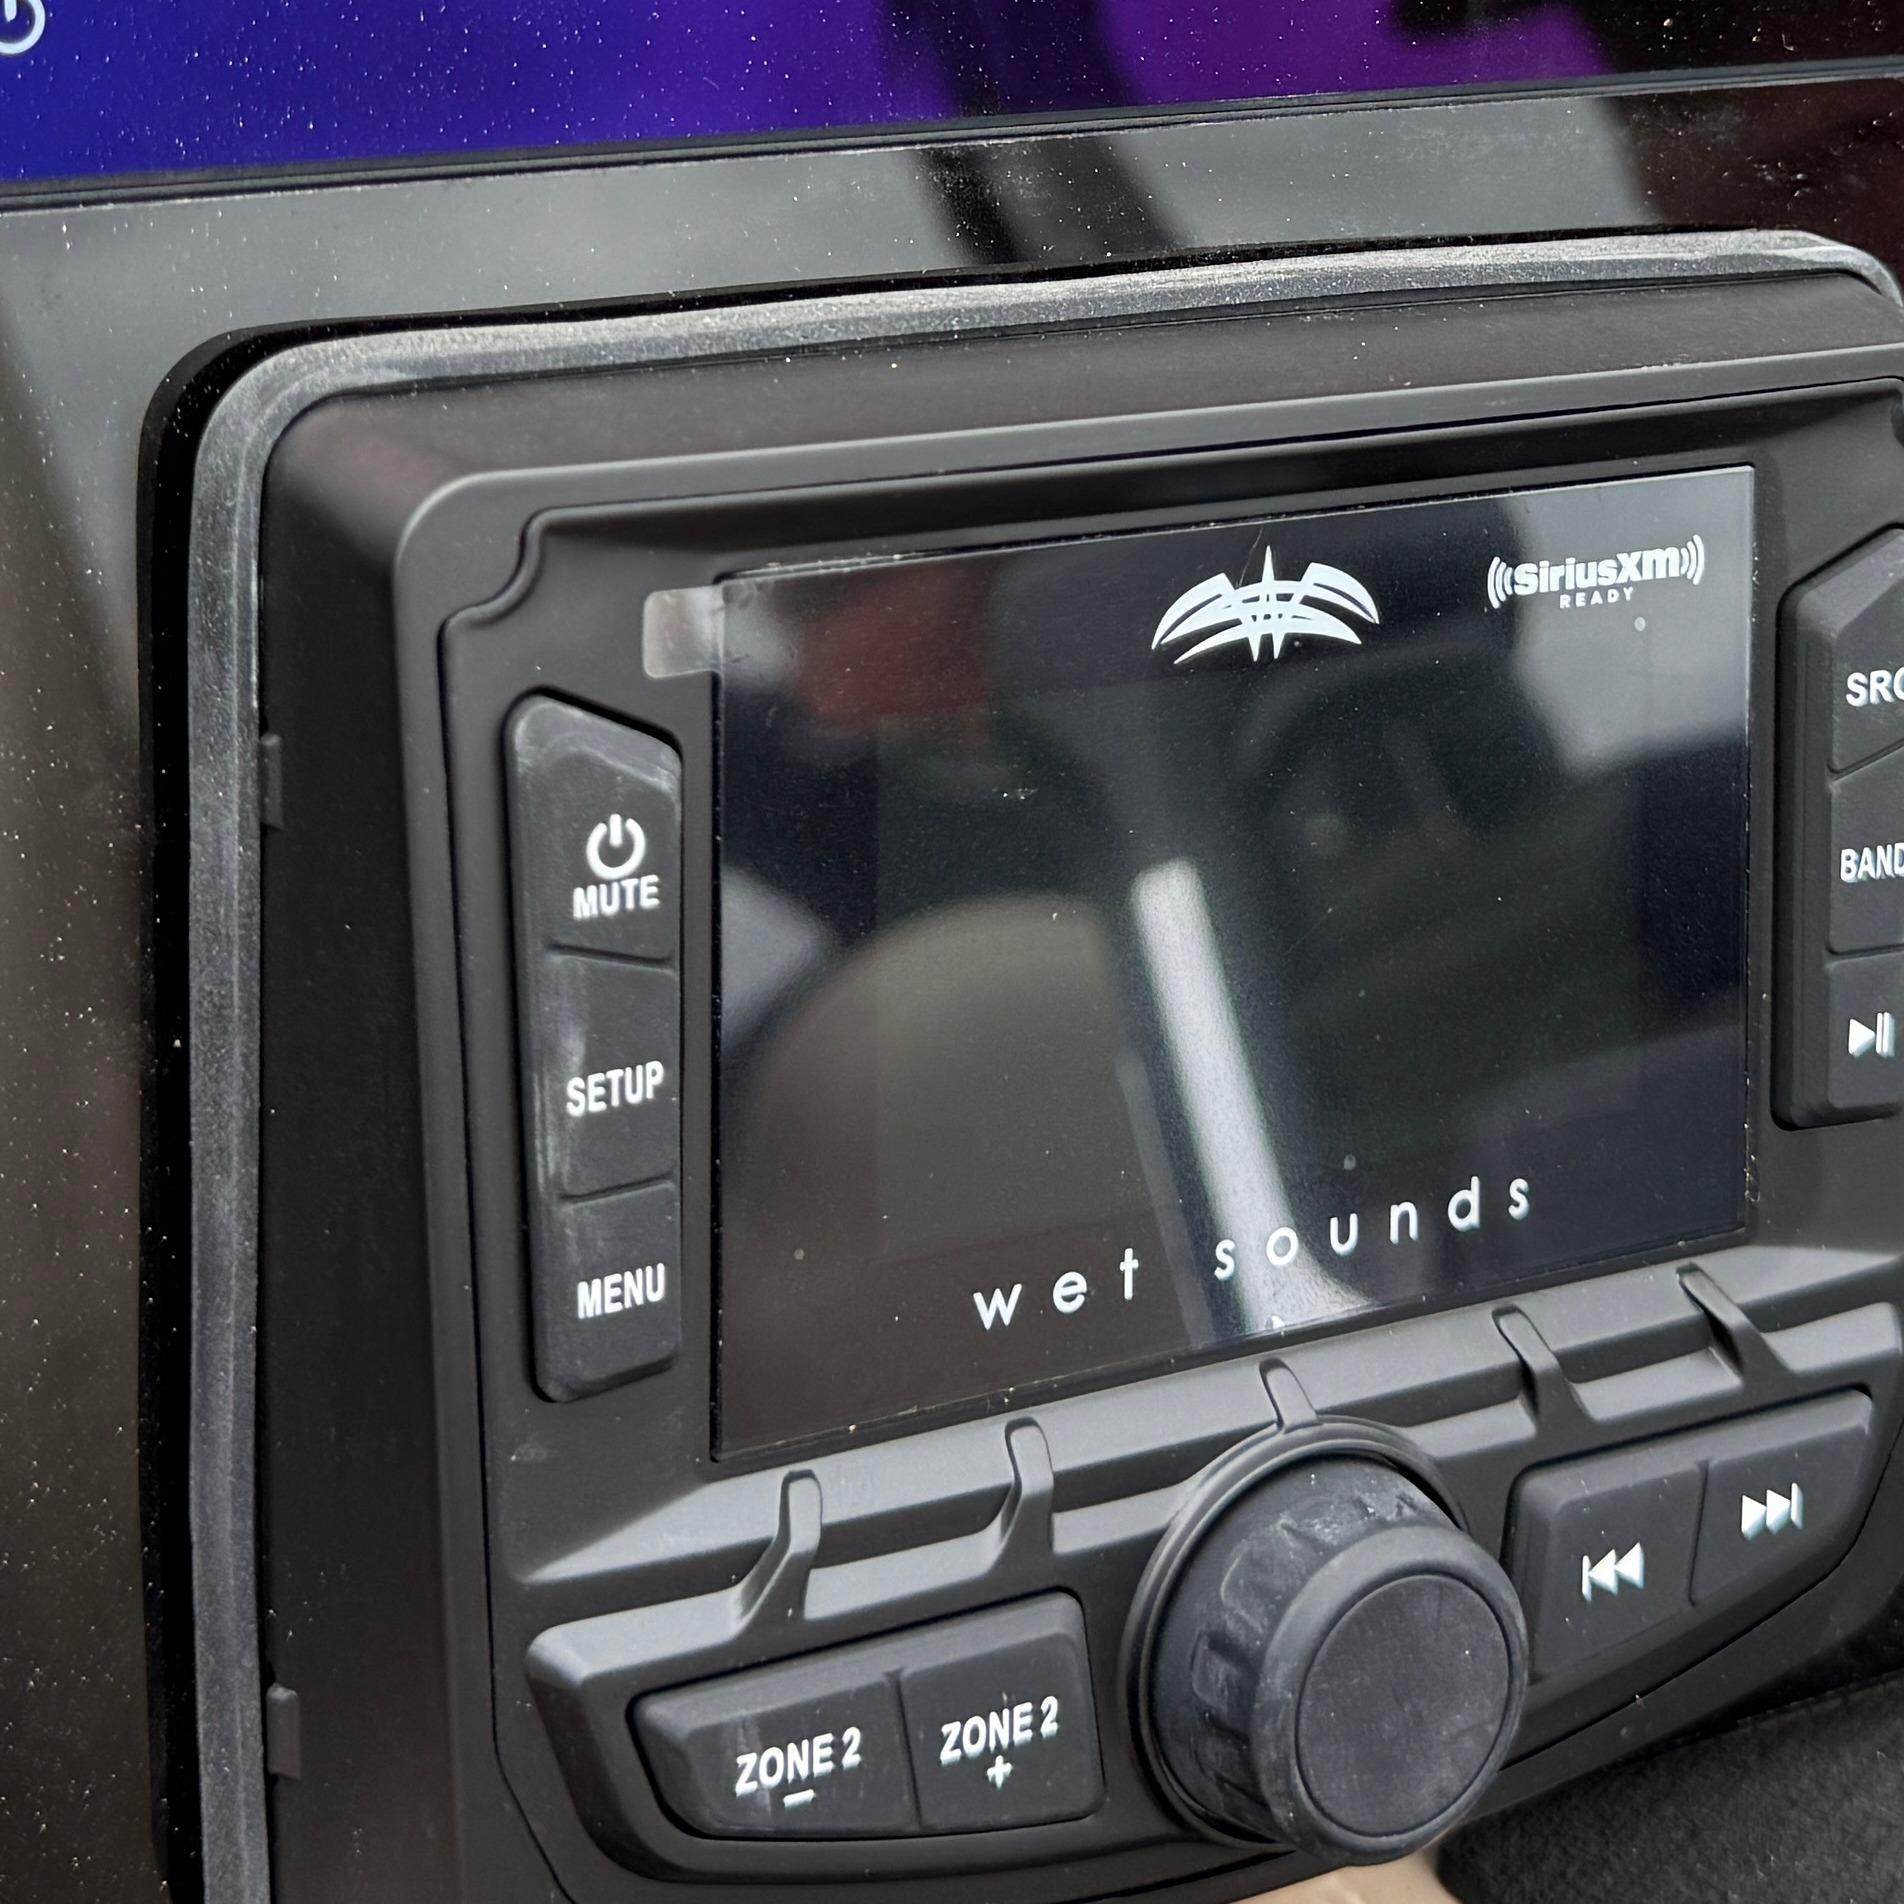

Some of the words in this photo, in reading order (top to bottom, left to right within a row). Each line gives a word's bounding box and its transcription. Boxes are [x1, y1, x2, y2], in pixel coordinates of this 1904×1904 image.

[1559, 586, 1635, 609] READY
[572, 874, 660, 921] MUTE
[566, 1059, 664, 1118] SETUP
[972, 1247, 1140, 1330] wet
[1214, 1176, 1531, 1281] sounds
[577, 1262, 666, 1319] MENU
[939, 1700, 1034, 1766] ZONE
[1040, 1695, 1060, 1739] 2
[734, 1732, 835, 1797] ZONE
[841, 1726, 862, 1771] 2
